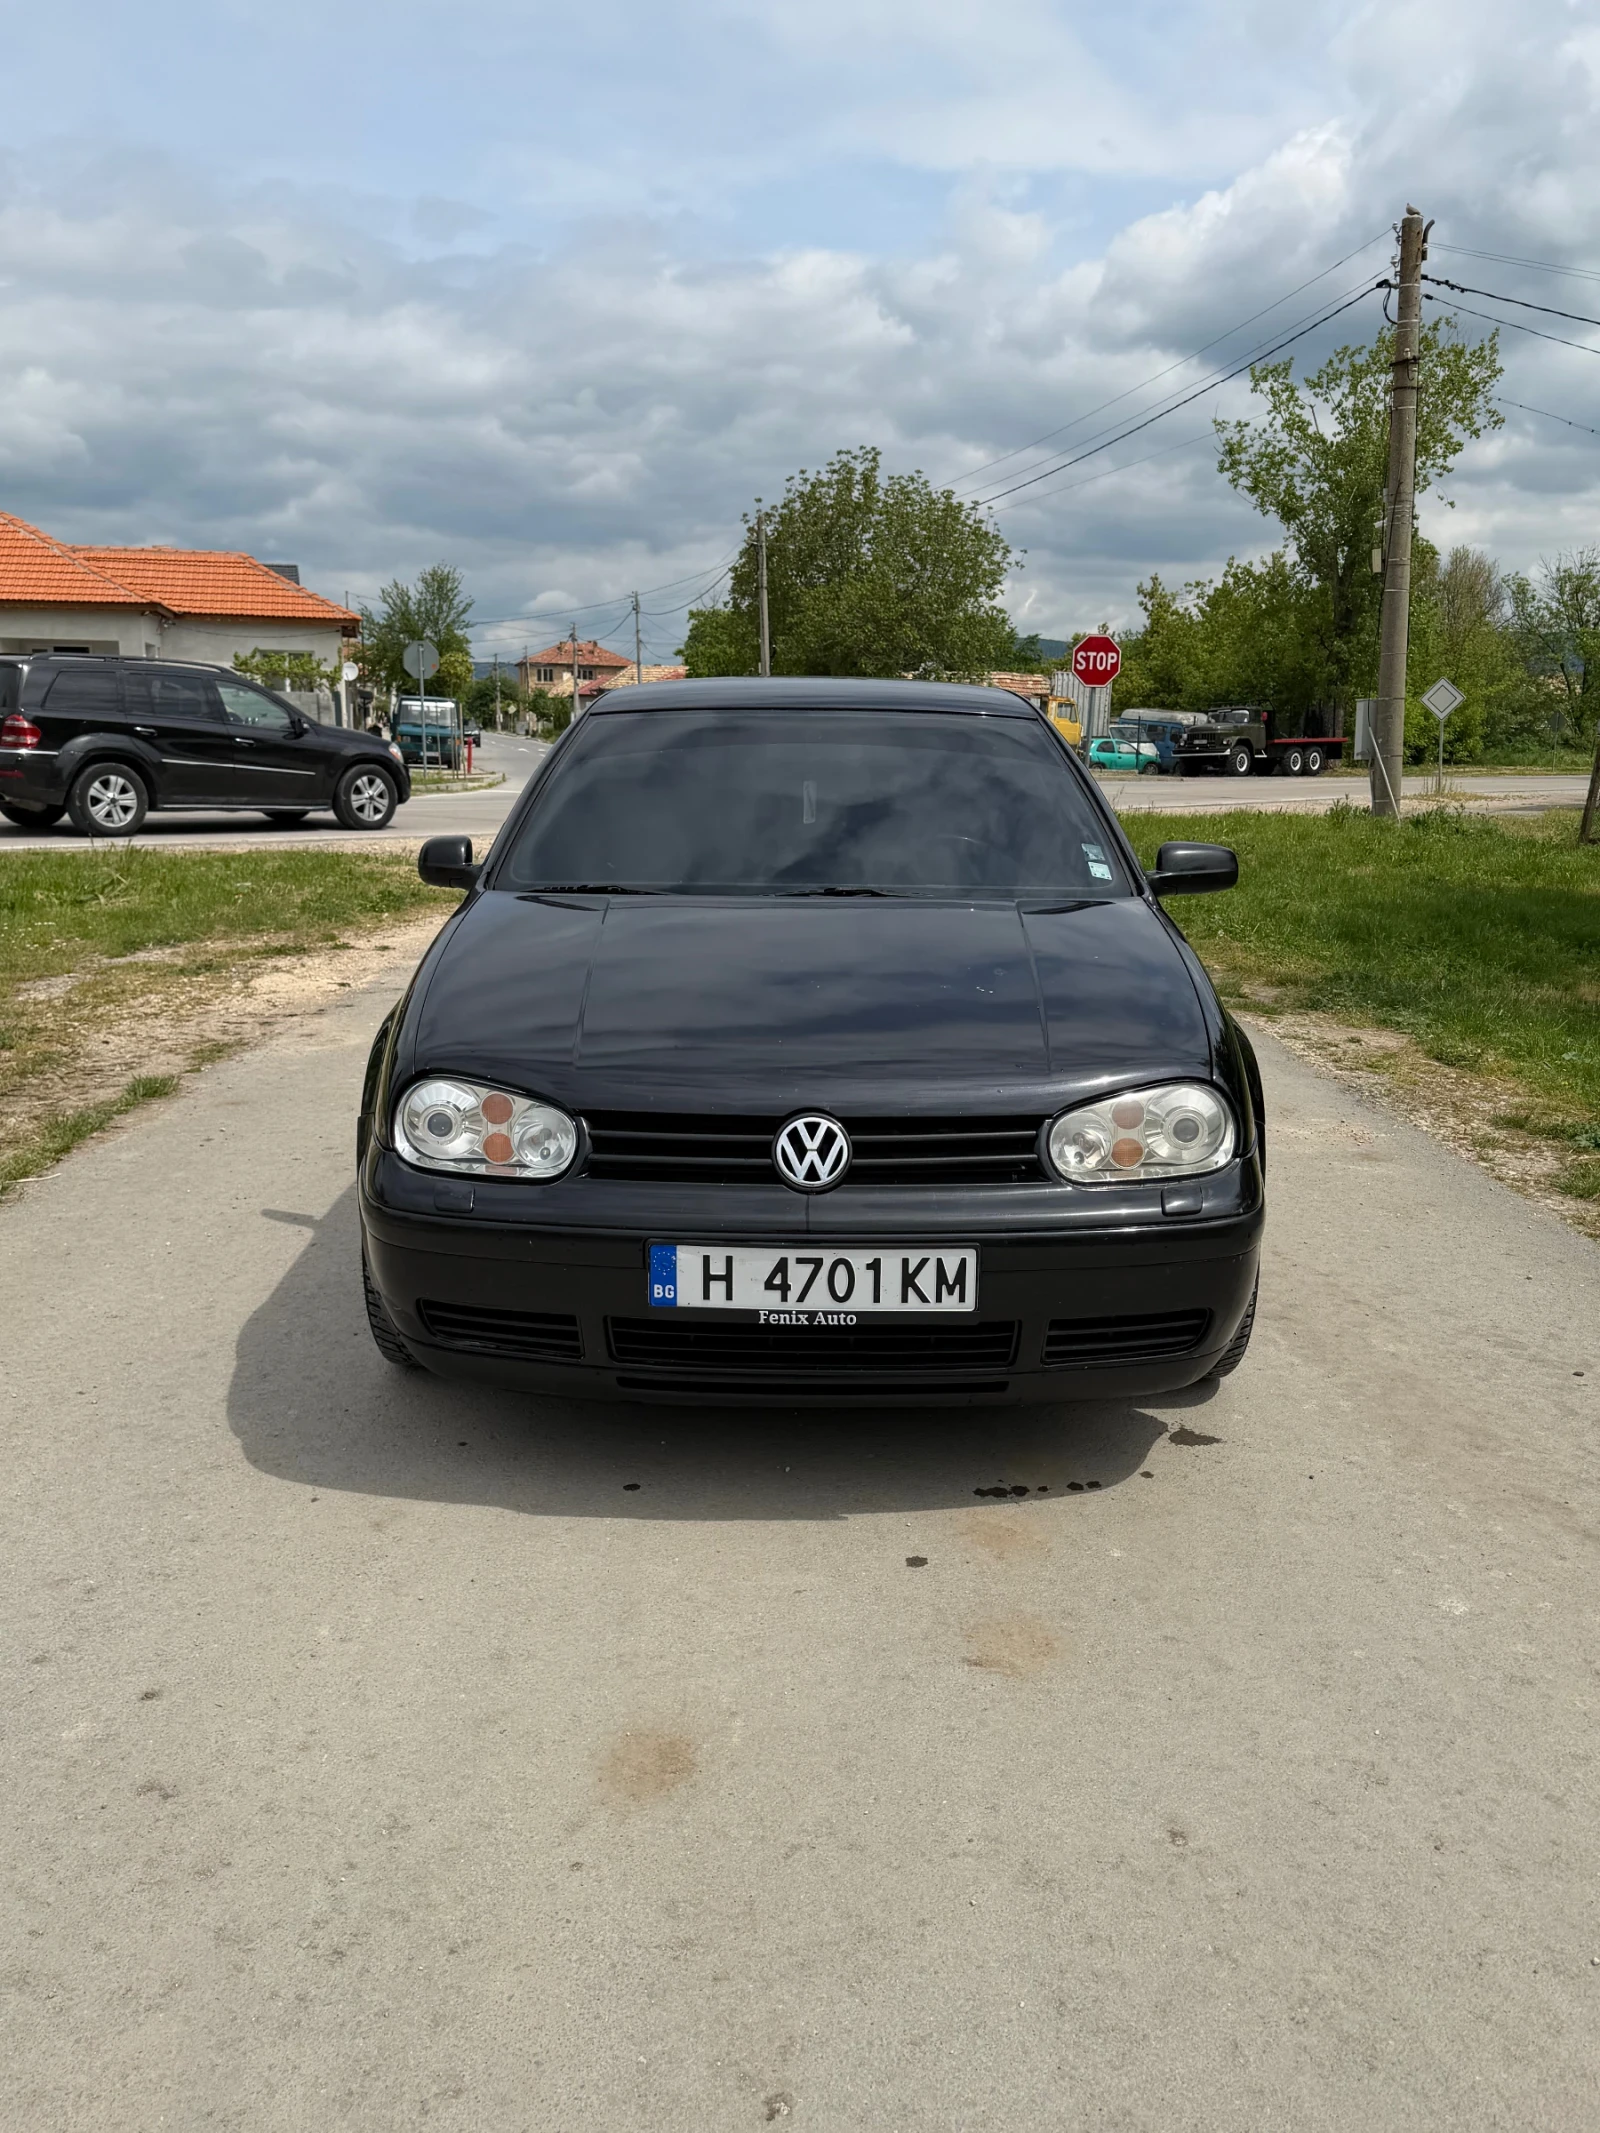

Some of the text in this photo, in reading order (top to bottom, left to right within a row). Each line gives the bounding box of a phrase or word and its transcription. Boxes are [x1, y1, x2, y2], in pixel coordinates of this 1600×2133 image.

[1076, 651, 1117, 670] STOP
[702, 1255, 734, 1301] H
[653, 1284, 675, 1299] BG
[758, 1310, 858, 1326] Fenix Auto
